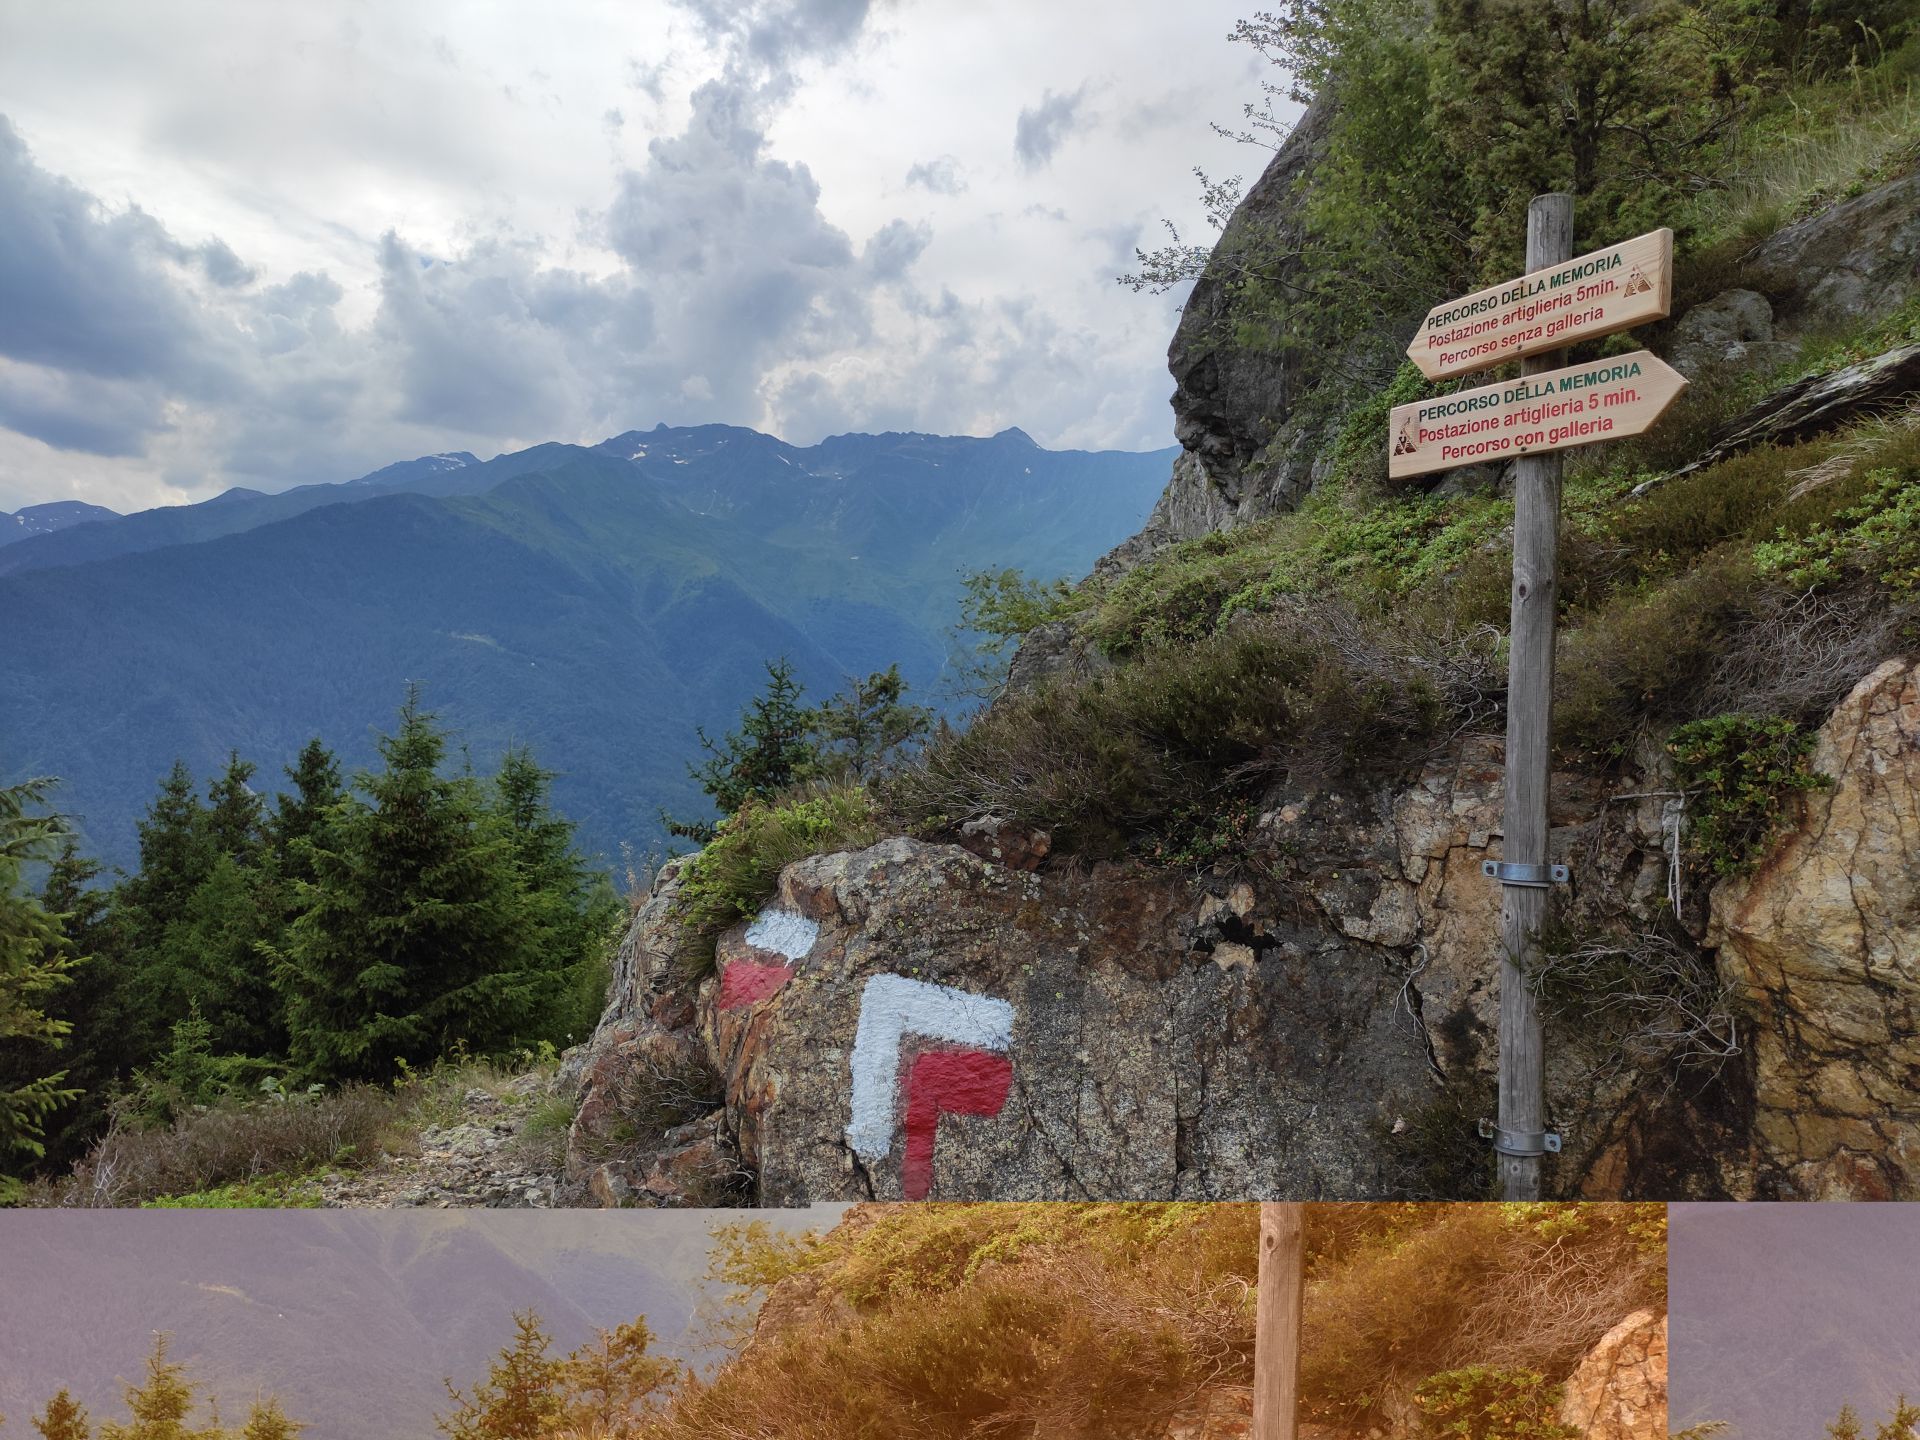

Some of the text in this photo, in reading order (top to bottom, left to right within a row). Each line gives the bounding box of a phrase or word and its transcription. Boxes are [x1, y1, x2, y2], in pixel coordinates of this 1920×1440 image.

[1427, 253, 1622, 330] PERCORSO DELLA MEMORIA
[1428, 318, 1498, 349] Postazione
[1502, 292, 1572, 325] artiglieria
[1439, 306, 1604, 367] Percorso senza galleria
[1419, 362, 1641, 422] PERCORSO DELLA MEMORIA
[1419, 387, 1641, 443] Postazione artiglieria 5 min.
[1442, 416, 1613, 460] Percorso con galleria
